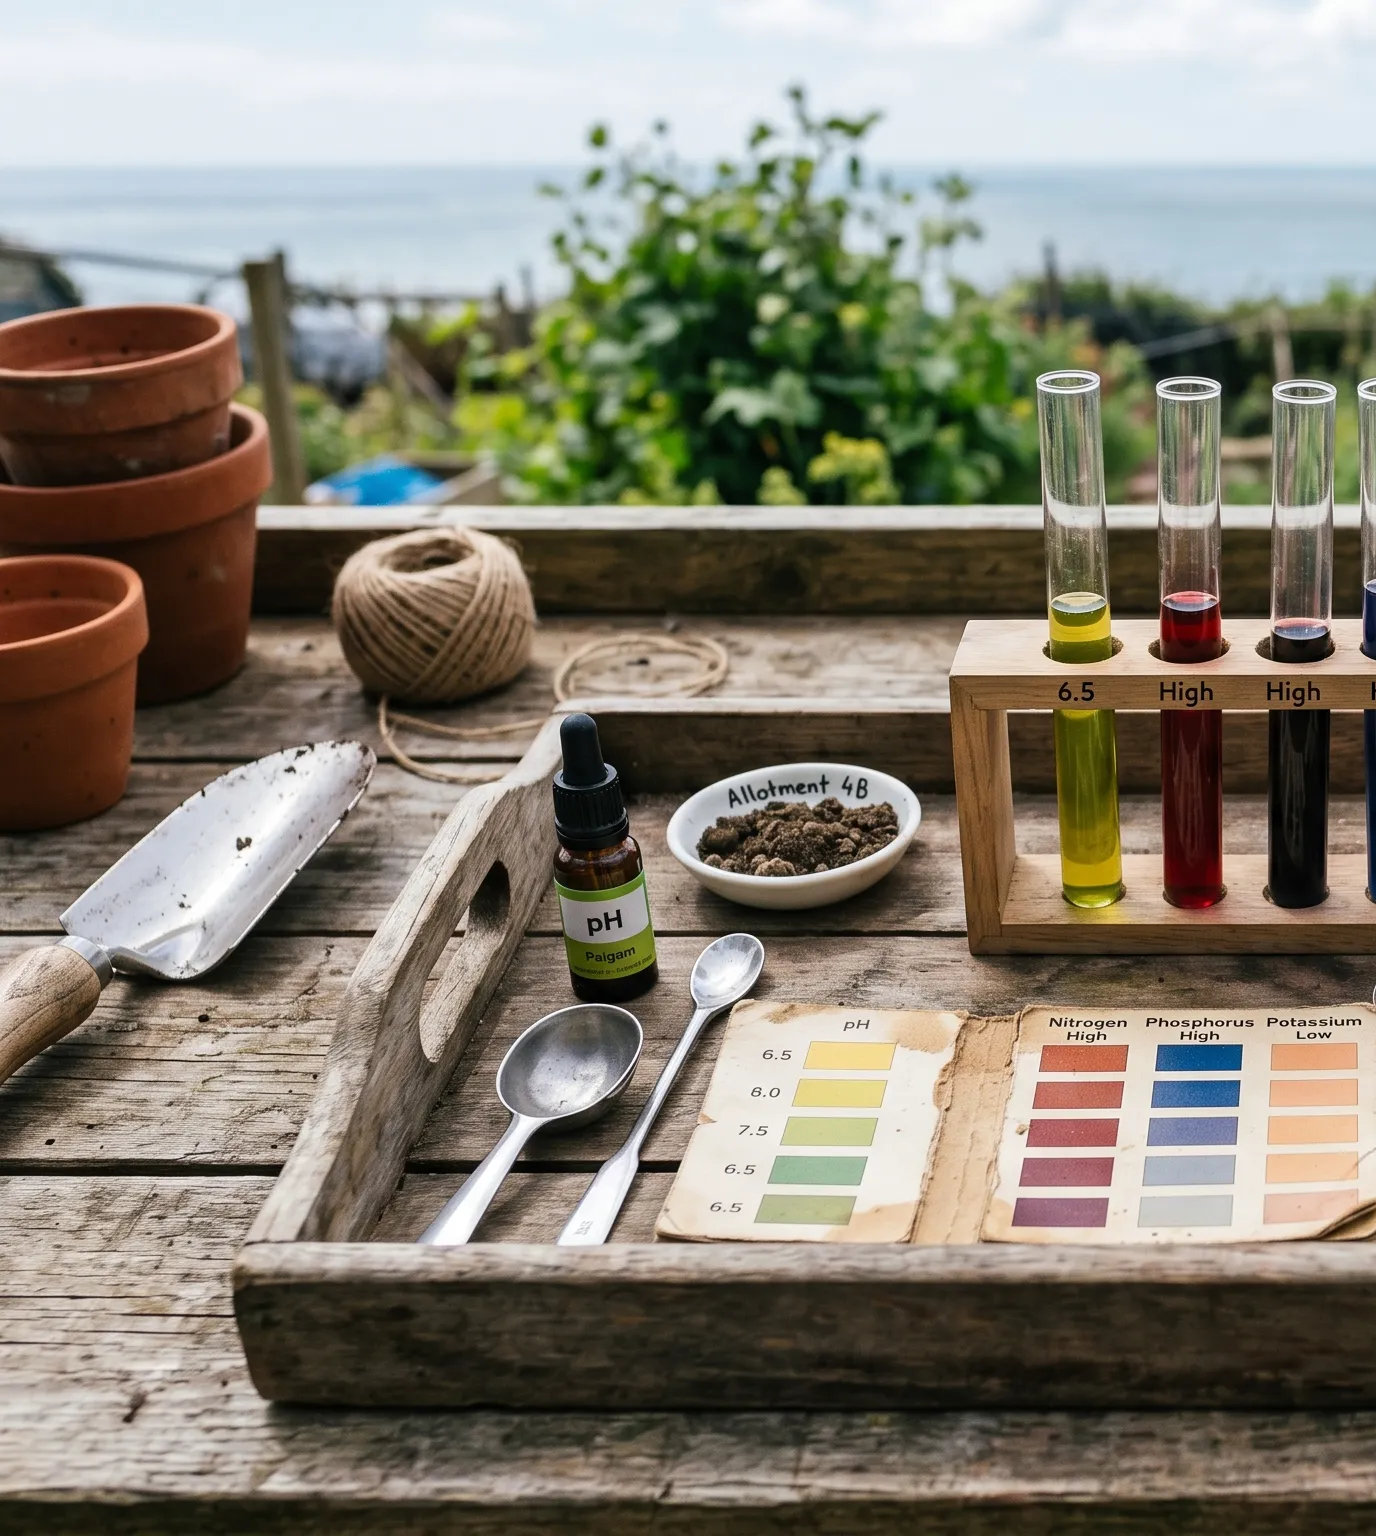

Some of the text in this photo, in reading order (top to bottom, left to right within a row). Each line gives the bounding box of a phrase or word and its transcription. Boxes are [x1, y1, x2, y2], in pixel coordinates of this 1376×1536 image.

[1058, 681, 1095, 702] 6.5
[1159, 680, 1214, 708] High
[1266, 680, 1321, 708] High
[728, 774, 869, 809] Allotment 4B
[586, 909, 623, 937] pH
[585, 947, 636, 964] Paigam
[843, 1019, 871, 1032] pH
[1048, 1015, 1363, 1031] Nitrogen Phosphorus Potassium
[1065, 1028, 1333, 1042] High High Low
[762, 1049, 792, 1061] 6.5
[738, 1124, 769, 1136] 7.5
[724, 1164, 756, 1175] 6.5
[709, 1202, 742, 1213] 6.5
